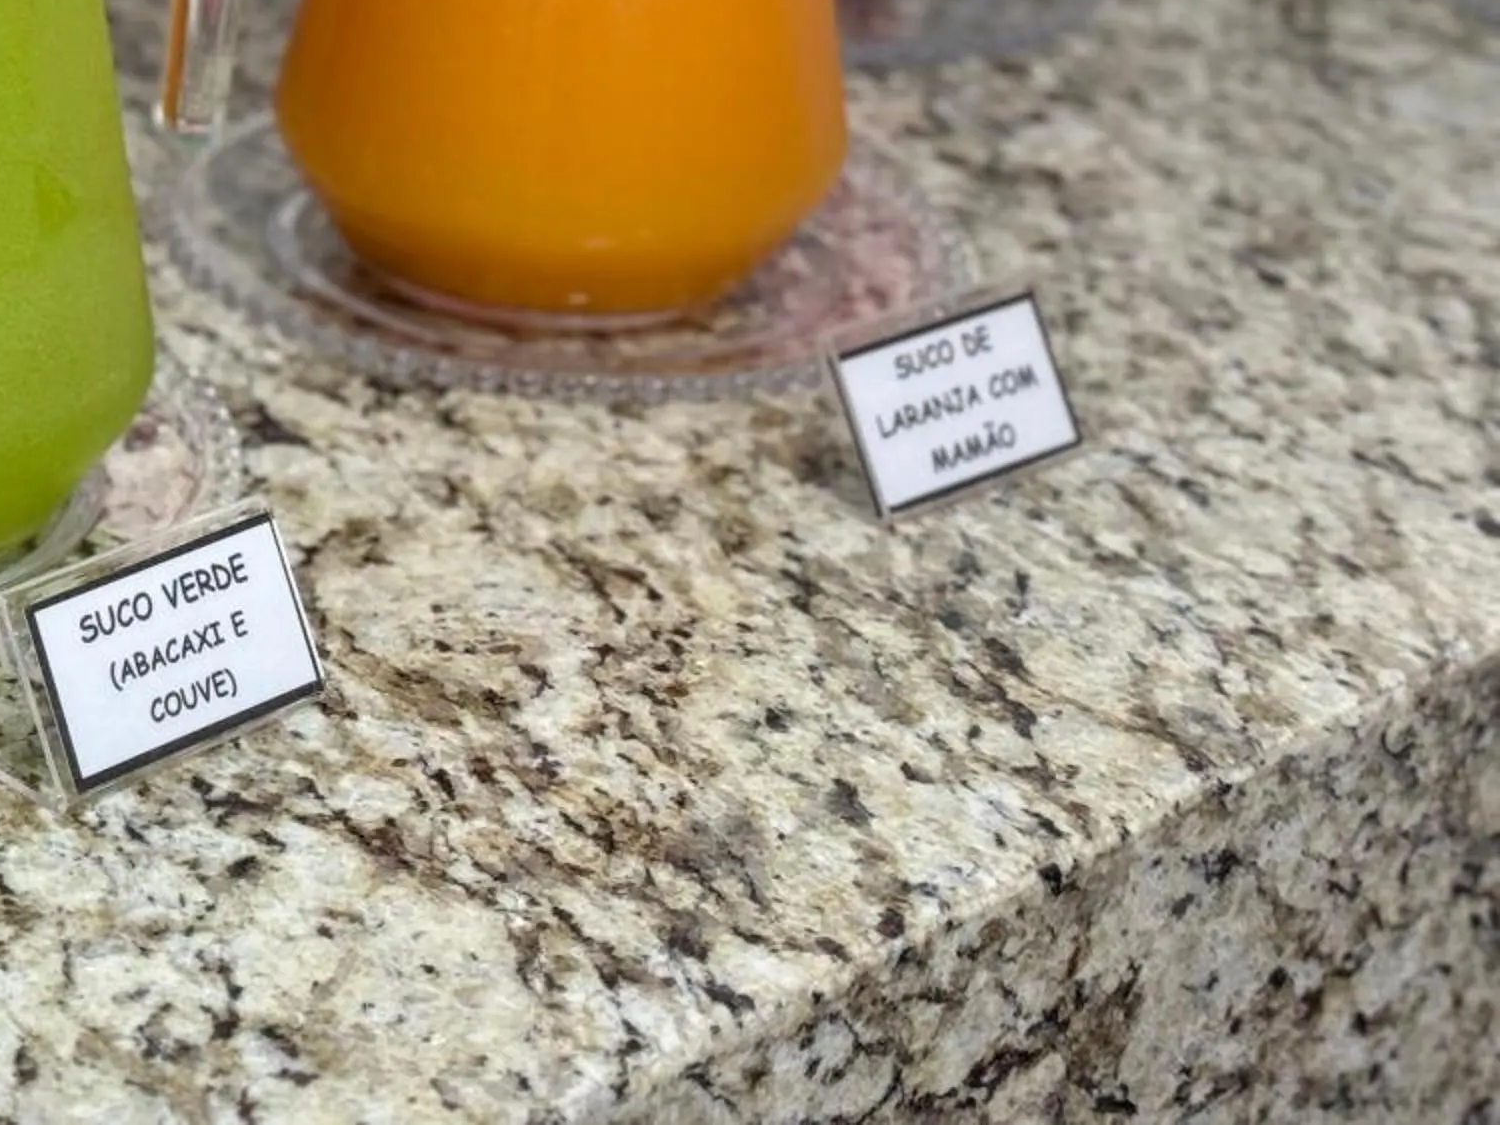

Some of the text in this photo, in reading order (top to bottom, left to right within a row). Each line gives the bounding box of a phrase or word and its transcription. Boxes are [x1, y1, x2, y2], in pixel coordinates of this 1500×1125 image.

[894, 325, 993, 379] SUCO DE
[876, 363, 1040, 440] LARANJA COM
[931, 421, 1016, 474] MAMÃO
[79, 552, 249, 643] SUCO VERDE
[110, 611, 249, 691] (ABACAXI E
[150, 668, 238, 723] COUVE)
